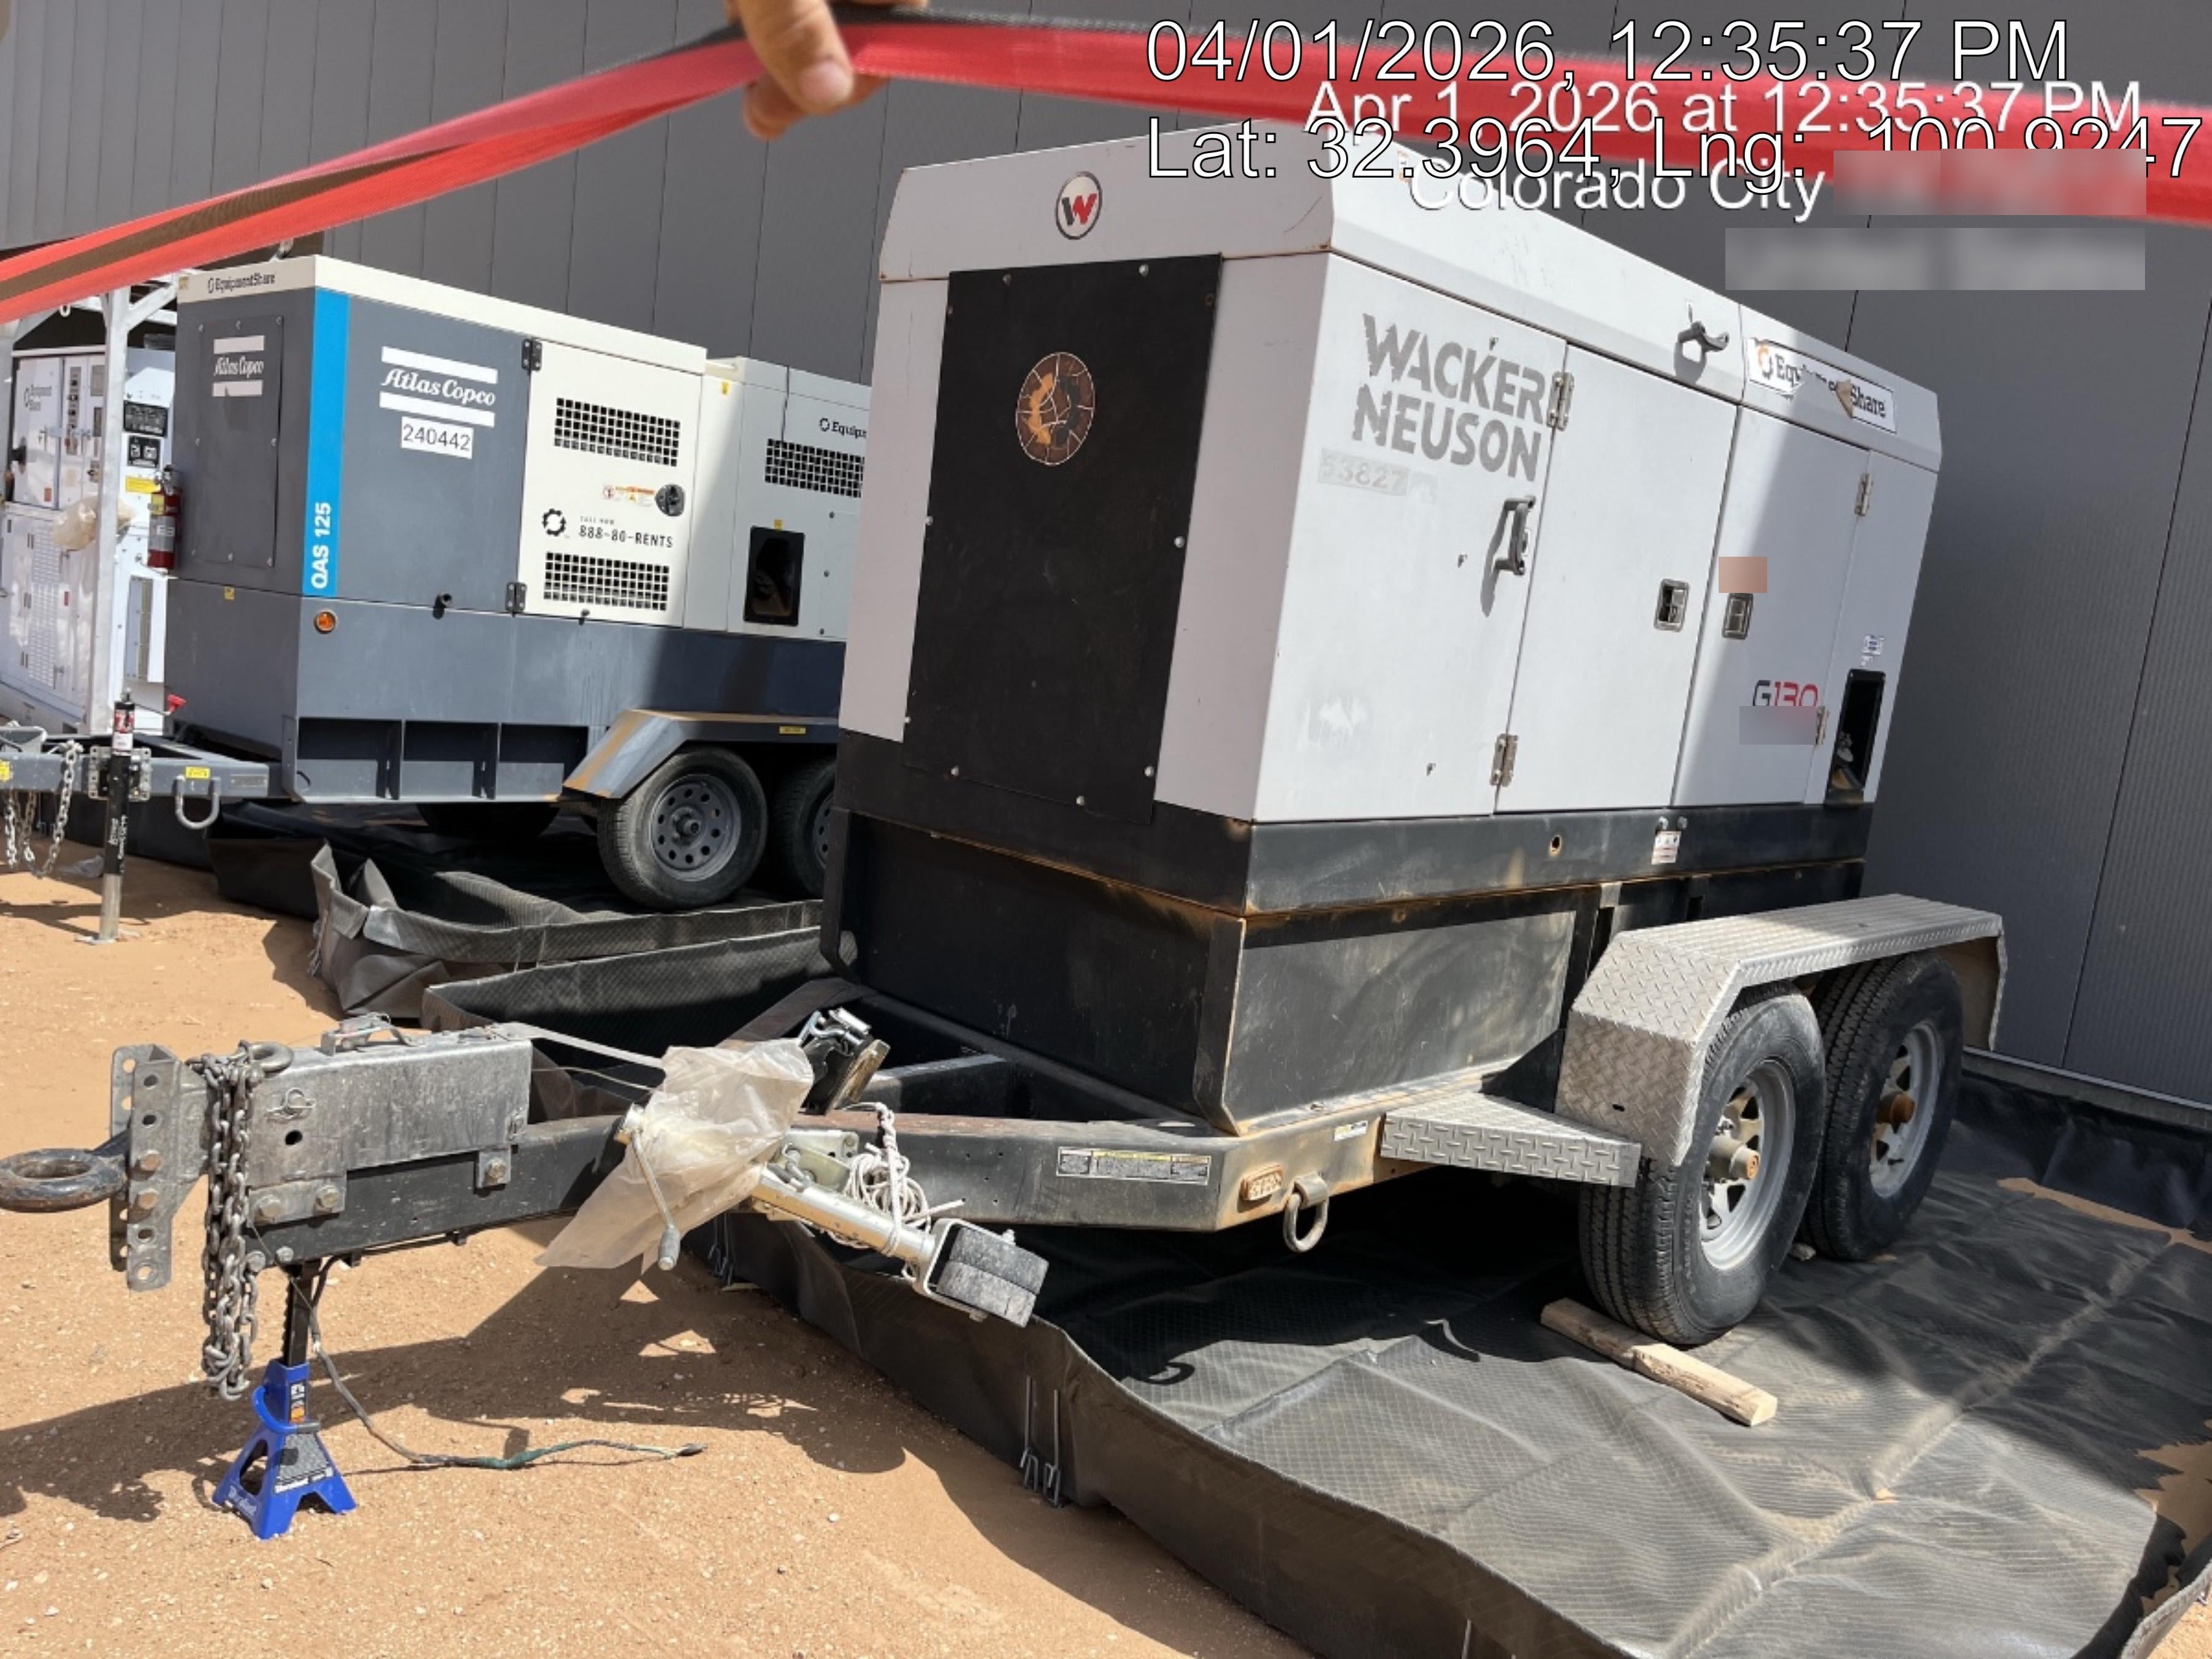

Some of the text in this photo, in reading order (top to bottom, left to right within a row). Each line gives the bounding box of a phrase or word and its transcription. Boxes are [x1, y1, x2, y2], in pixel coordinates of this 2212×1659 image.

[381, 368, 496, 407] Atlas Copco
[1362, 313, 1547, 425] WACKER
[402, 422, 473, 452] 240442
[1351, 382, 1543, 483] NEUSON
[312, 501, 332, 590] QAS 125
[578, 524, 674, 548] 888-80-RENTS
[1751, 679, 1818, 707] G130
